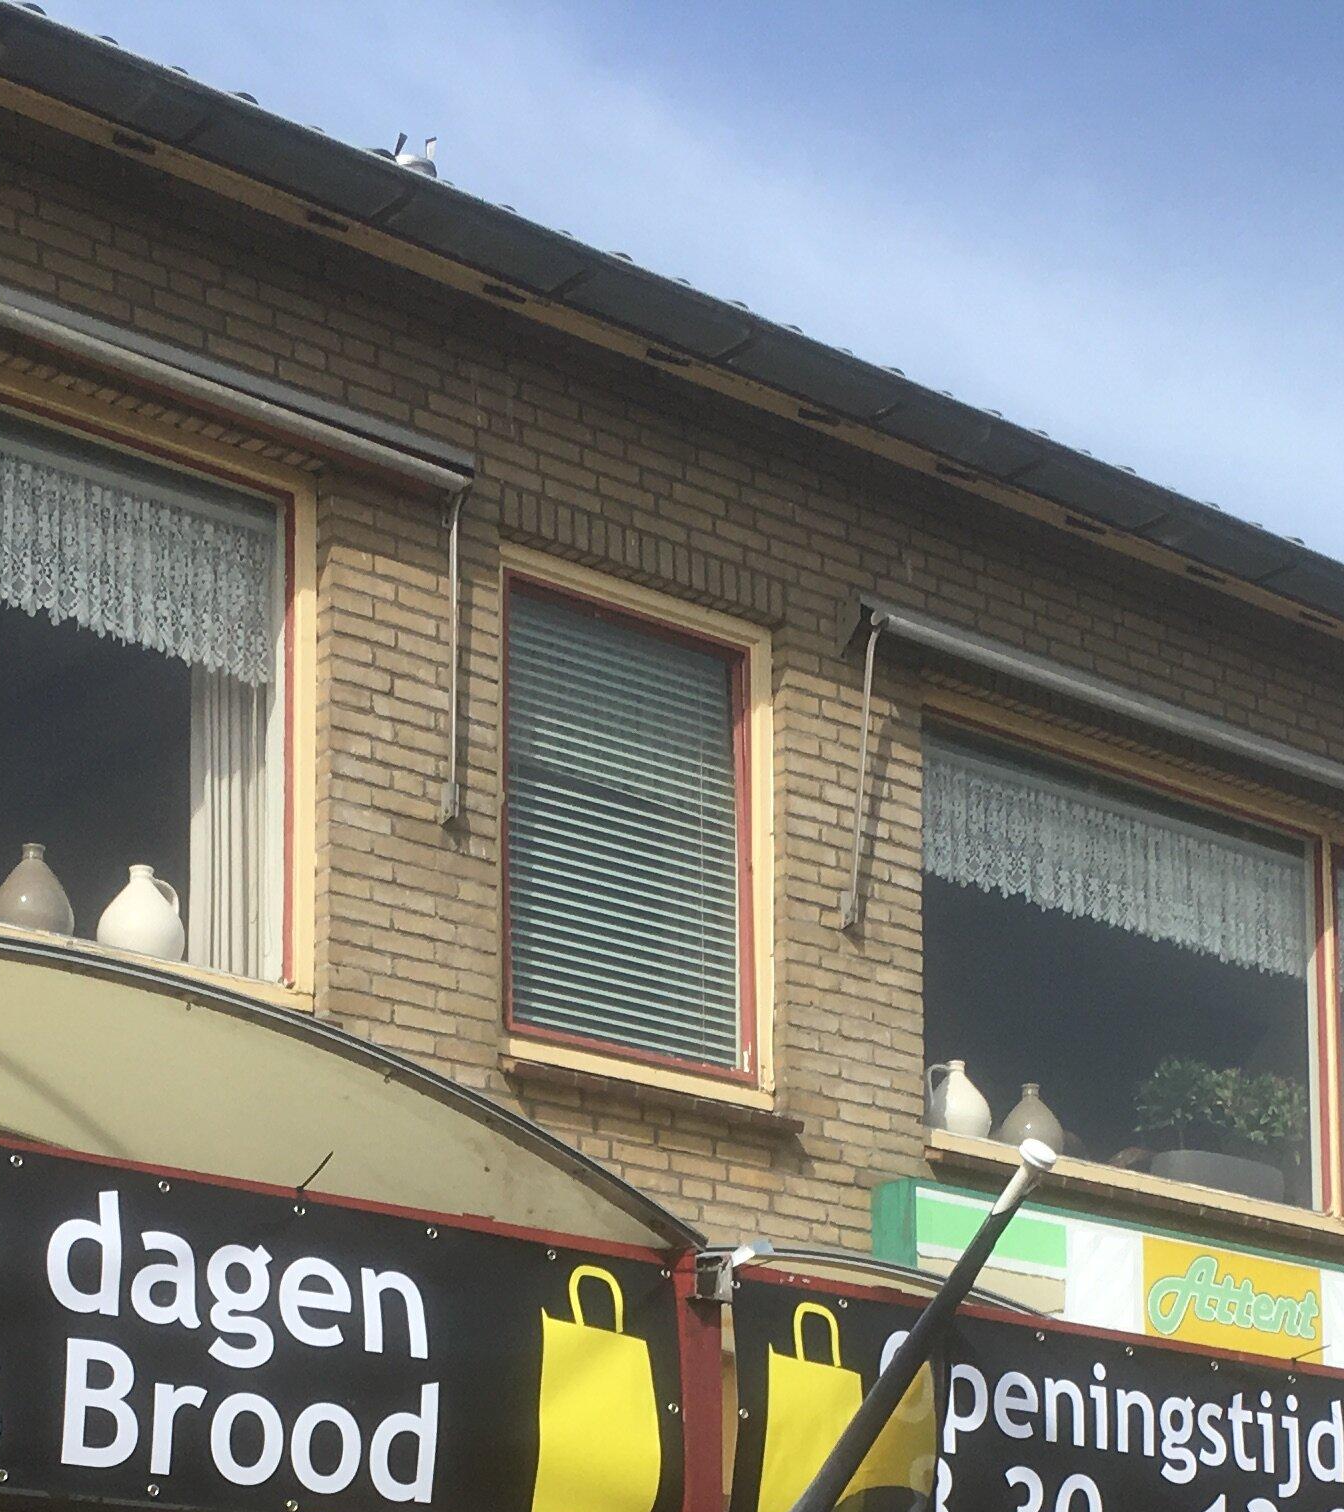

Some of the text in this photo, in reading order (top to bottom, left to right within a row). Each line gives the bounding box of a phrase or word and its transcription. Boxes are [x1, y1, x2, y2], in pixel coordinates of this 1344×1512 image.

[46, 1190, 429, 1369] dagen
[1147, 1255, 1319, 1340] Attent
[60, 1337, 440, 1504] Brood
